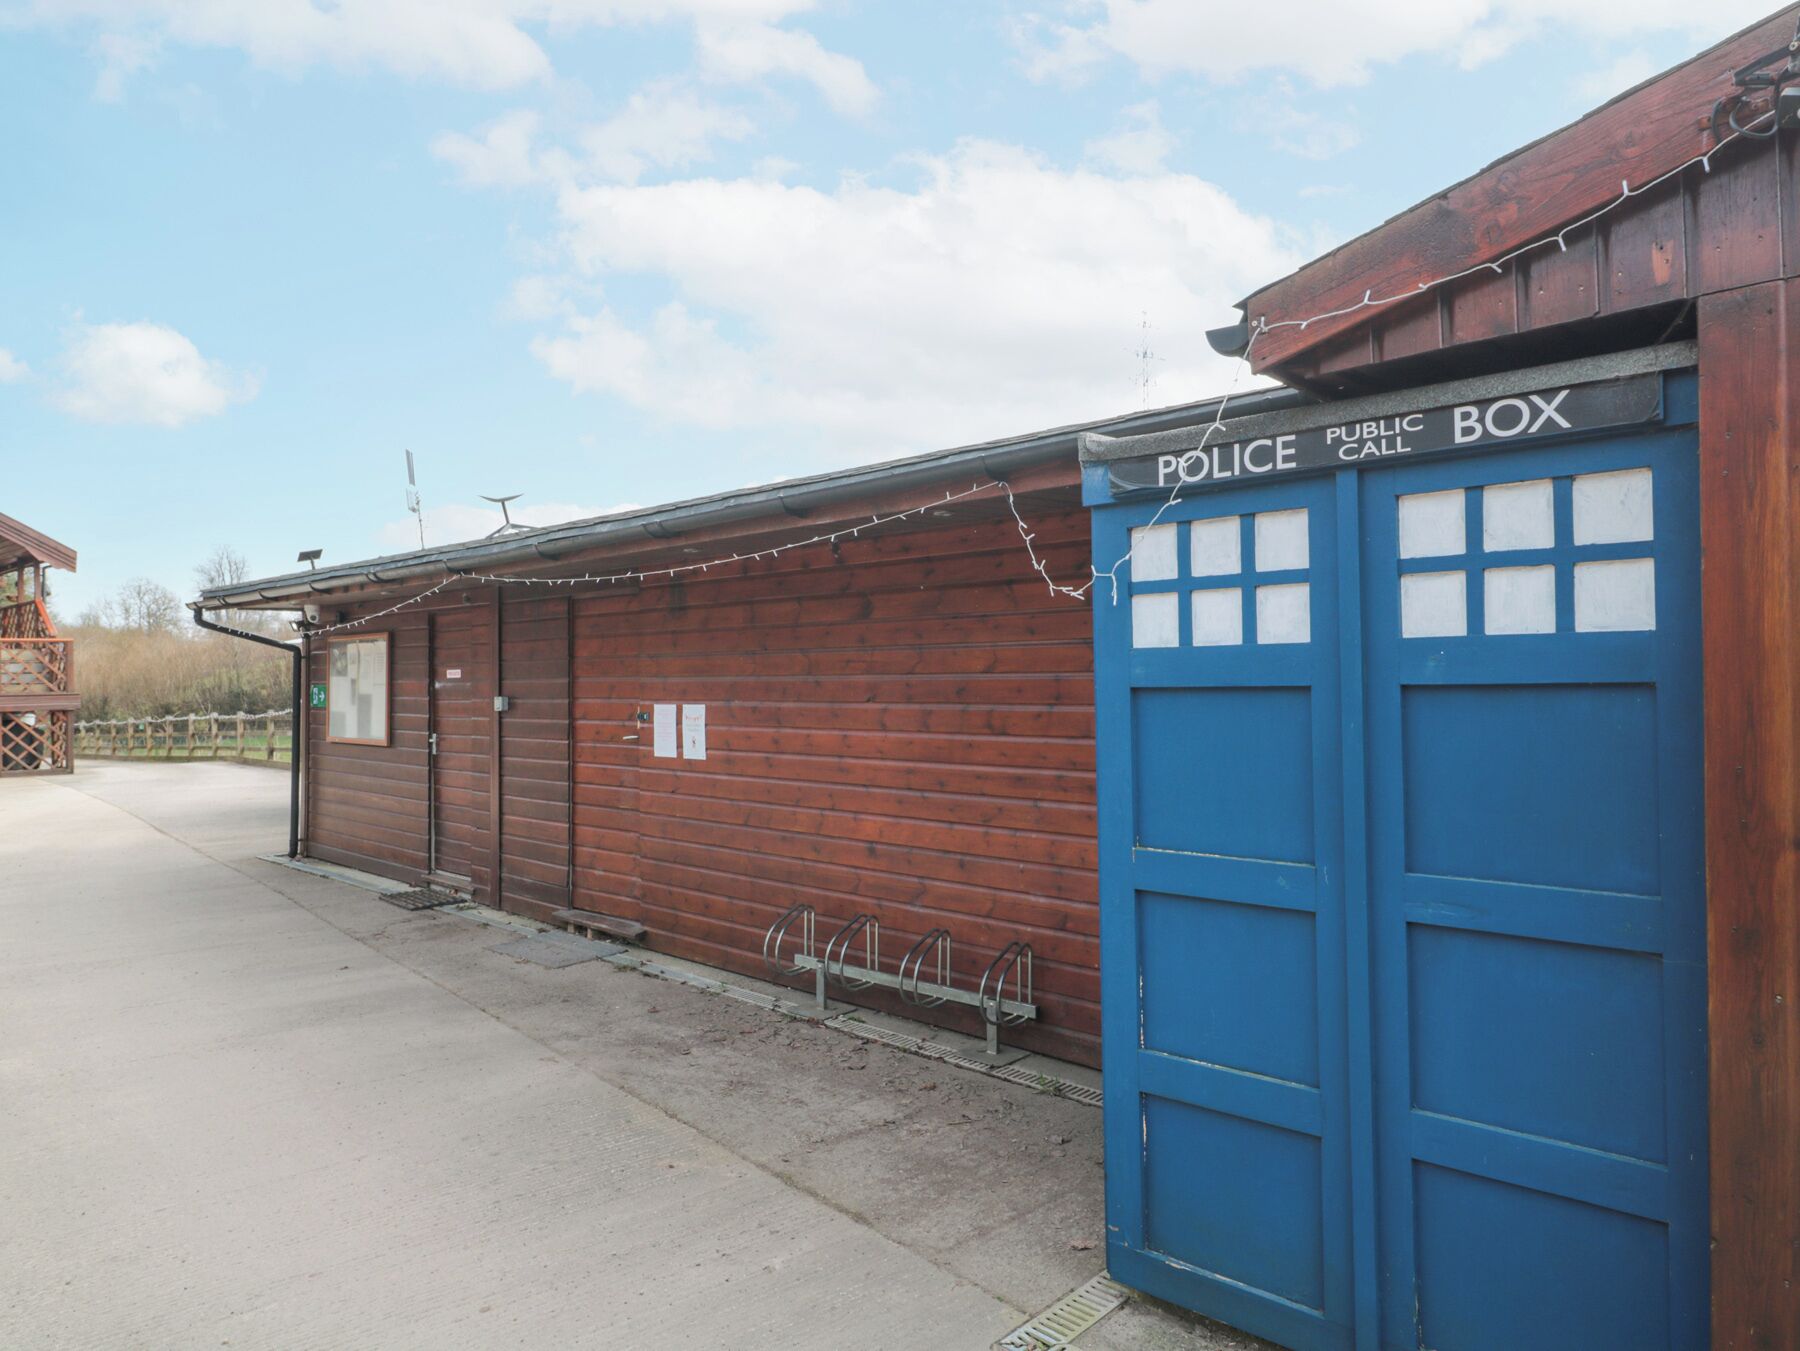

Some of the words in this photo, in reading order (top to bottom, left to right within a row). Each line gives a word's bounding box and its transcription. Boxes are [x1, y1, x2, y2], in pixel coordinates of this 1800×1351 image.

[1326, 415, 1424, 444] PUBLIC
[1454, 390, 1571, 444] BOX
[1157, 436, 1297, 486] POLICE
[1338, 435, 1411, 460] CALL
